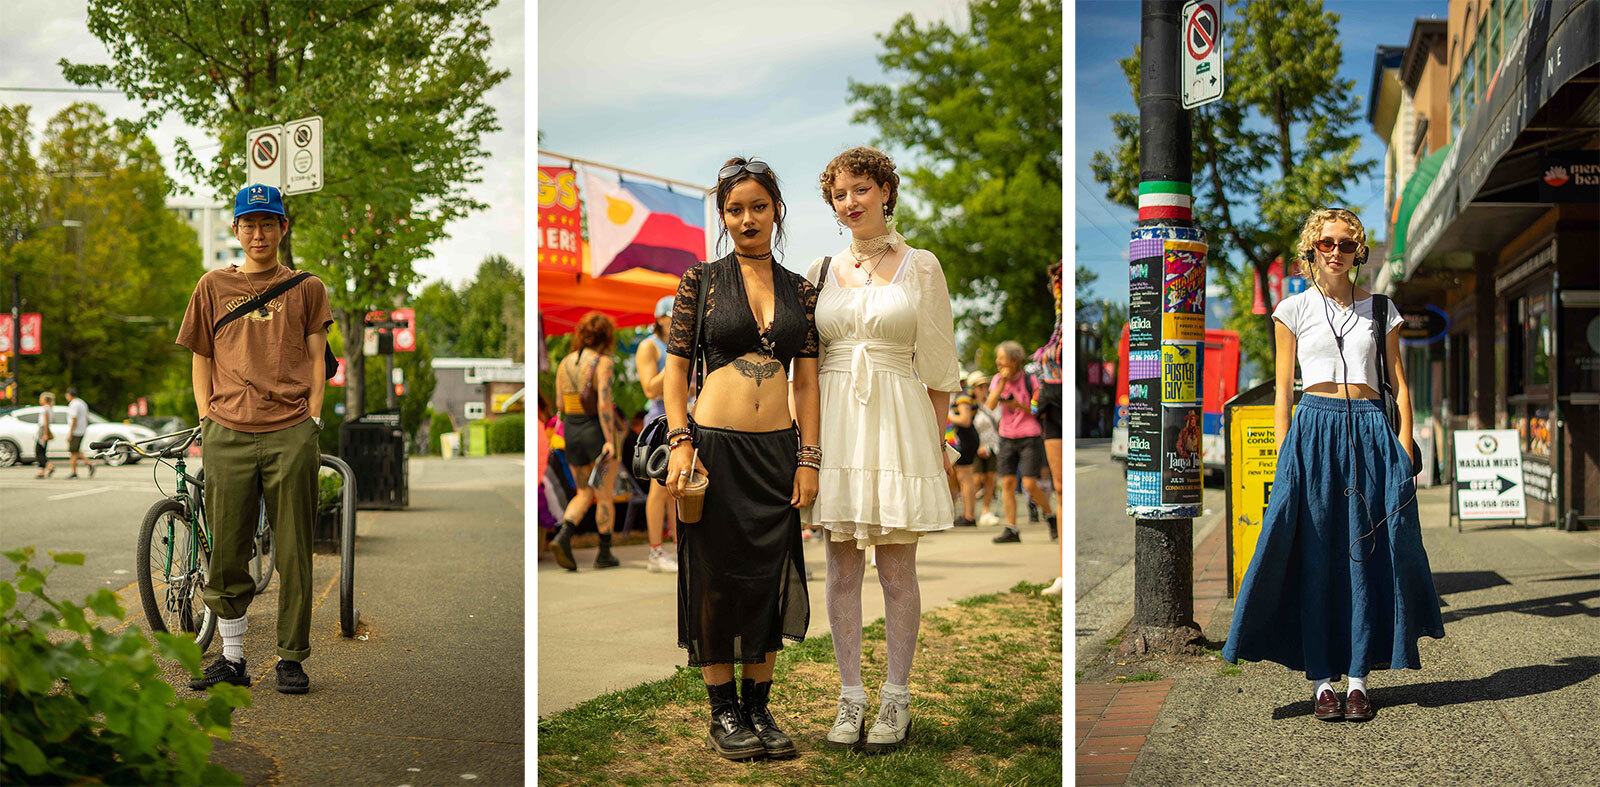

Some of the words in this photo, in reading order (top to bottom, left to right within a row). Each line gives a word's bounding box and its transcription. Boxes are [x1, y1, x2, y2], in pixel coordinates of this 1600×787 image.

[1164, 351, 1174, 363] the
[1165, 363, 1195, 382] POSTER
[1165, 381, 1184, 400] GUY.
[1166, 452, 1191, 473] Tanya
[1459, 458, 1491, 468] MASALA
[1493, 458, 1519, 467] MEATS
[1470, 480, 1503, 490] OPEN
